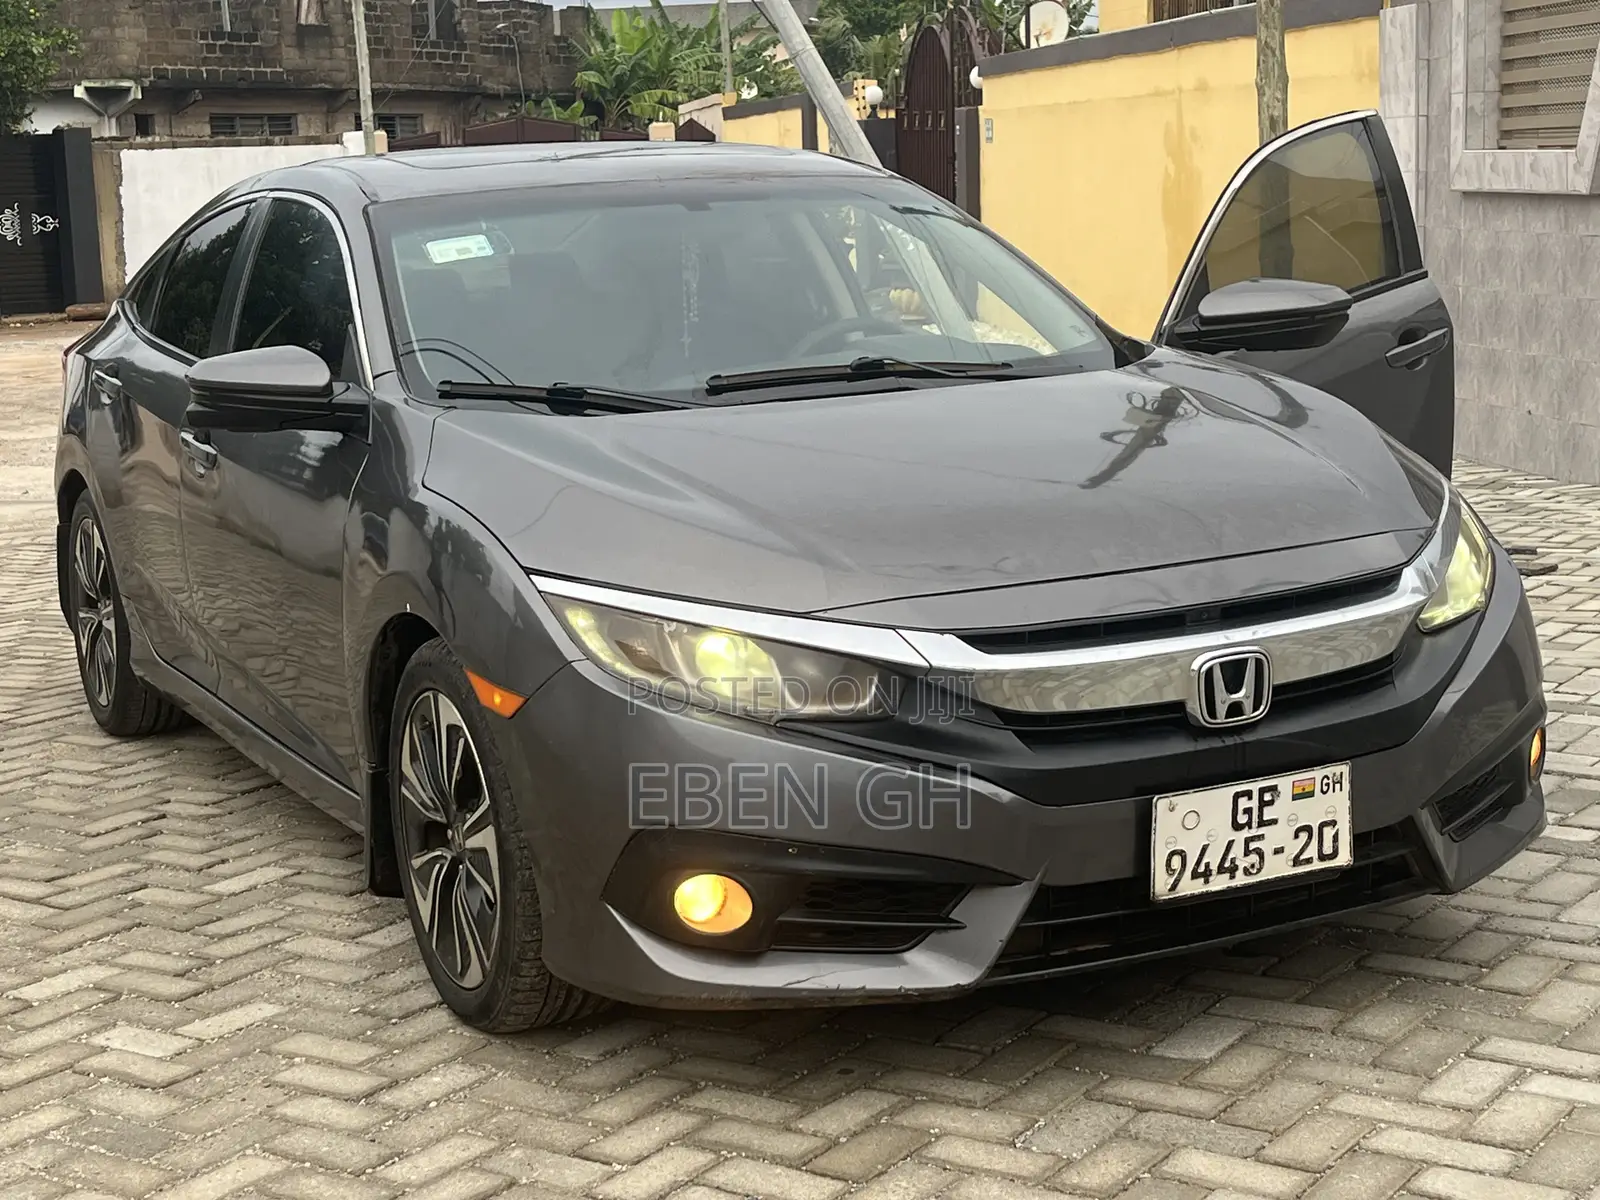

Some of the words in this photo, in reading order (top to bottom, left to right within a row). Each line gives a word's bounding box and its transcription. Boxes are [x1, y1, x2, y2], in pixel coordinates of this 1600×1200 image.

[1231, 784, 1280, 832] GE
[1320, 771, 1343, 795] GH
[1165, 819, 1340, 892] 9445-20
